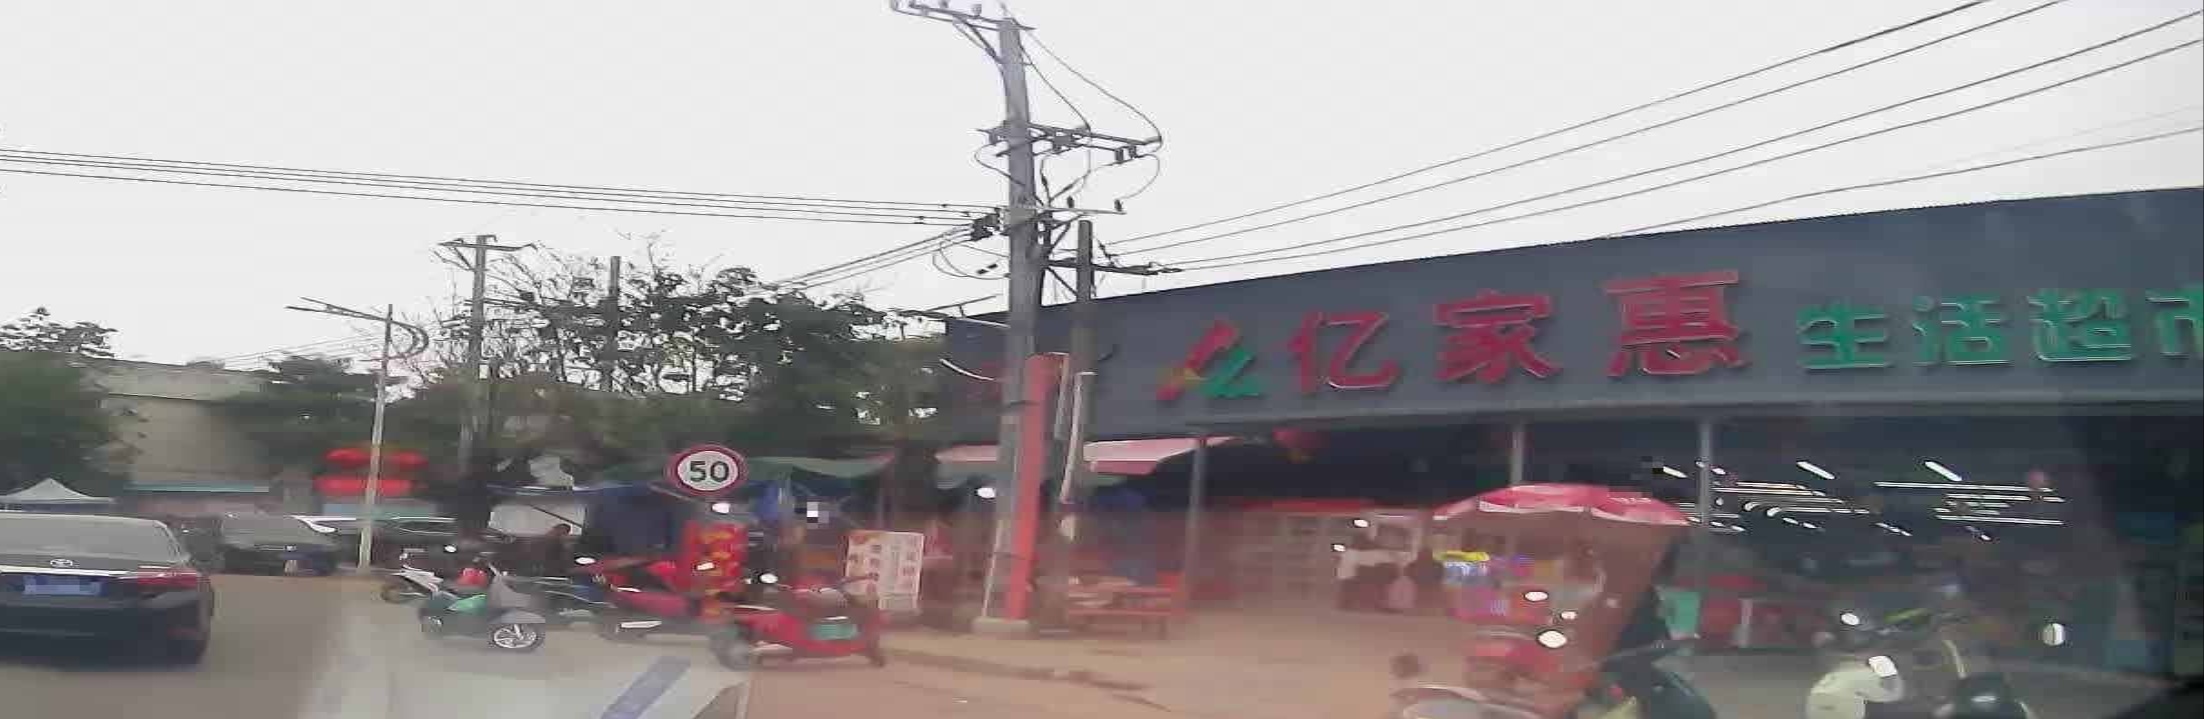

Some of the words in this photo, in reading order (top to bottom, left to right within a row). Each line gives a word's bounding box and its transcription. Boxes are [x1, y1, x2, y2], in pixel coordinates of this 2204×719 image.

[1289, 270, 1747, 394] 亿家惠
[689, 460, 730, 482] 50
